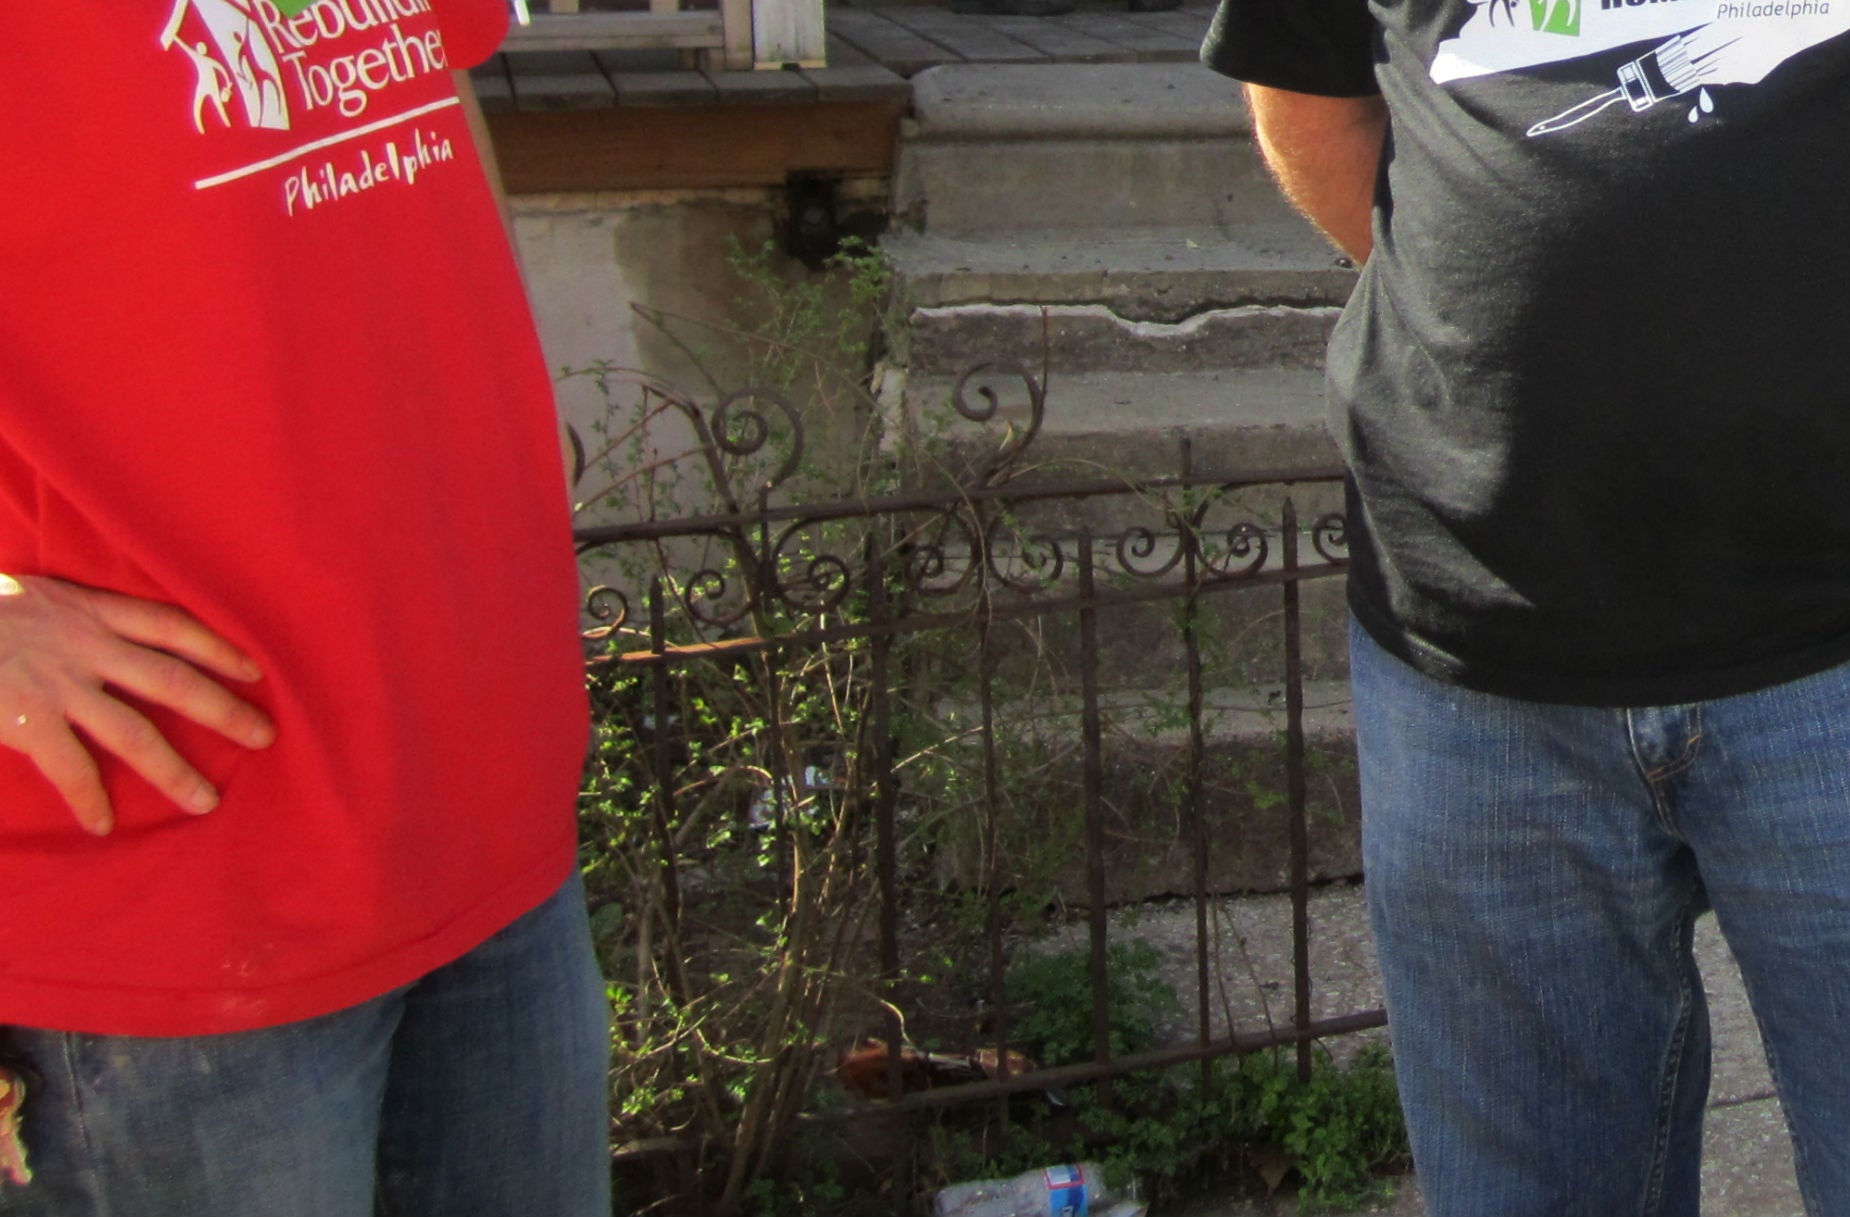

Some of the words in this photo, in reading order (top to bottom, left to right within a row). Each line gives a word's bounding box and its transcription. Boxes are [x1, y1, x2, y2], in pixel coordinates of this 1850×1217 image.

[1717, 0, 1830, 20] Philadelphia
[282, 23, 448, 118] Togethe
[284, 128, 454, 217] Philadelphia
